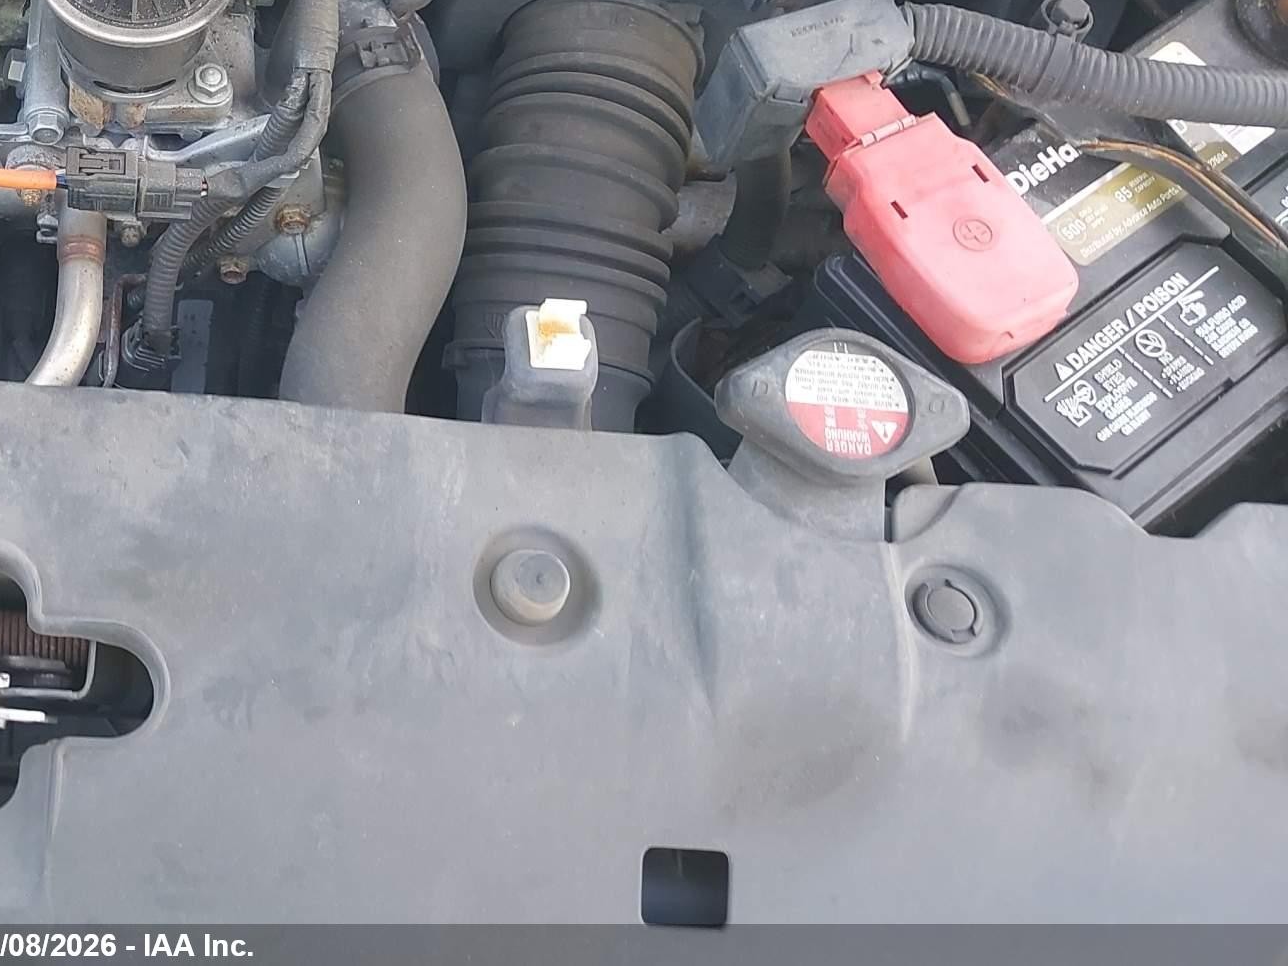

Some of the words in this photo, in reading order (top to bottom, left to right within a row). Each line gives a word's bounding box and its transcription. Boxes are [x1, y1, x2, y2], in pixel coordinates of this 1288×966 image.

[1007, 142, 1082, 195] DieHa
[1113, 185, 1133, 203] 85
[1061, 218, 1087, 241] 500
[1066, 318, 1130, 370] DANGER
[1133, 272, 1190, 319] POISON
[826, 438, 872, 455] DANGER
